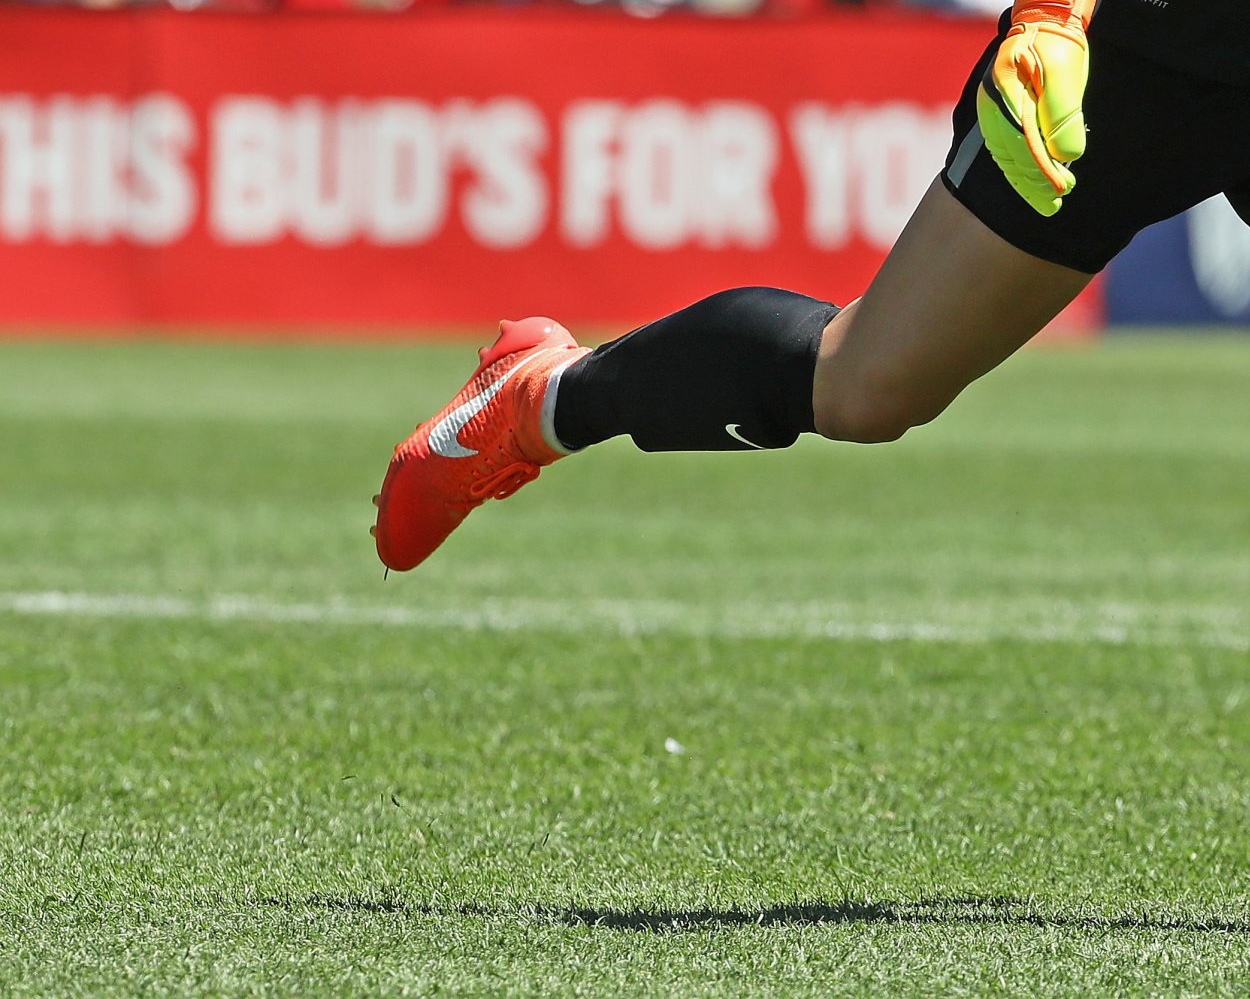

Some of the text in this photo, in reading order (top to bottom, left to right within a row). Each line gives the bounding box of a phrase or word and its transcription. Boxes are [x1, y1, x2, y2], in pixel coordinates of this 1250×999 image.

[0, 91, 955, 250] HIS BUD'S FOR YO
